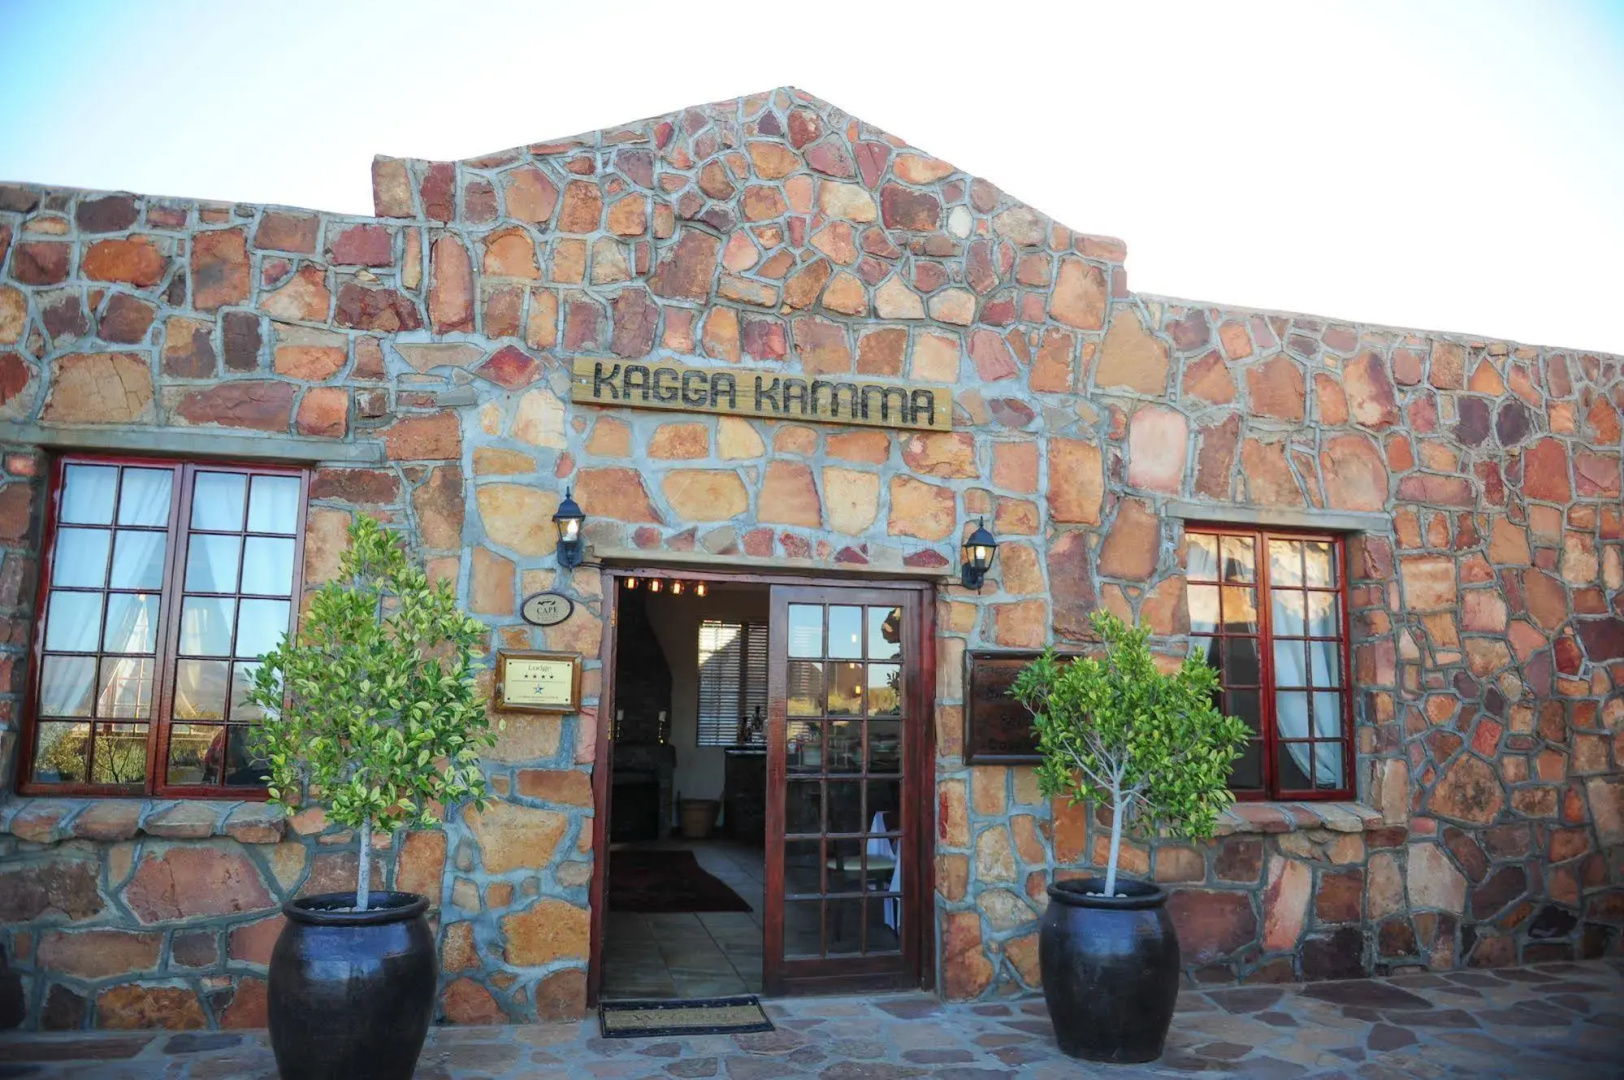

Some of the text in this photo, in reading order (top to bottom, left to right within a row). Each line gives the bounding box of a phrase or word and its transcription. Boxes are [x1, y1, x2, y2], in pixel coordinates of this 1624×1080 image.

[593, 361, 935, 426] KAGGA KAMMA
[528, 664, 552, 672] Lodge
